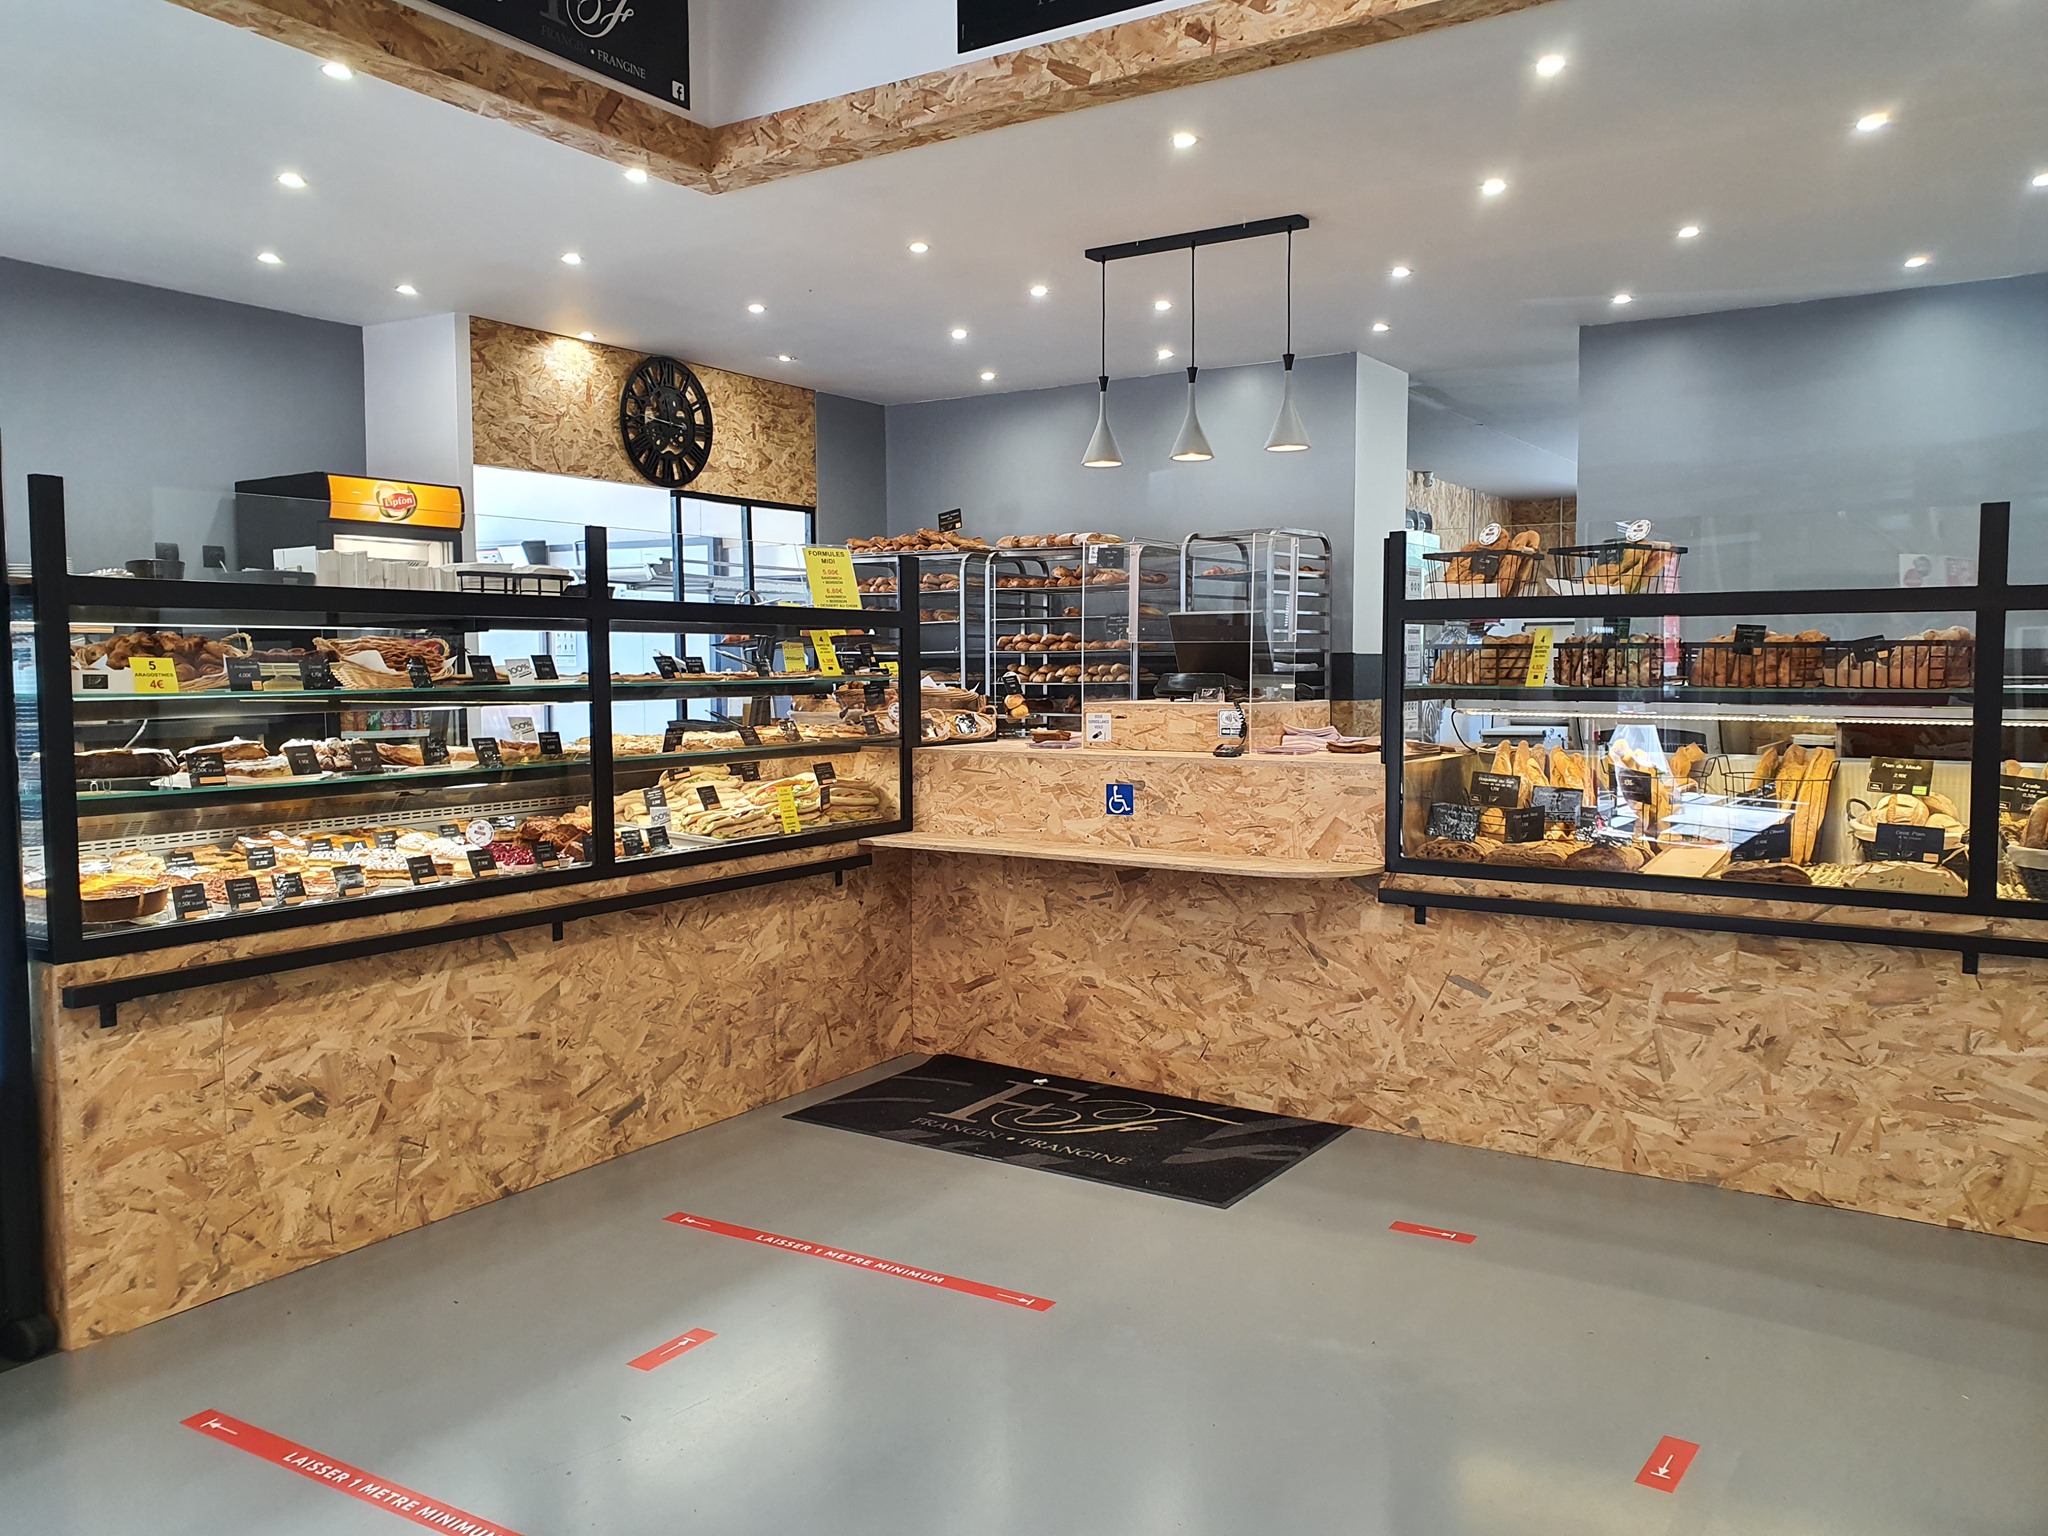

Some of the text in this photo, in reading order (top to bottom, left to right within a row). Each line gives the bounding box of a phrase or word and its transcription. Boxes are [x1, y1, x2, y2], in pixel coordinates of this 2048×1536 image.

[541, 25, 647, 80] FRANGIN FRANGINE
[383, 494, 414, 509] Lipton
[1541, 635, 1545, 643] 4
[148, 661, 157, 670] 5
[508, 664, 530, 675] 100%
[150, 680, 165, 689] 4€
[909, 1115, 1133, 1167] FRANGIN FRANGINE
[754, 1233, 946, 1285] LAISSER 1 METRE MINIMUM
[282, 1451, 503, 1536] LAISSER 1 METRE MINIMU
